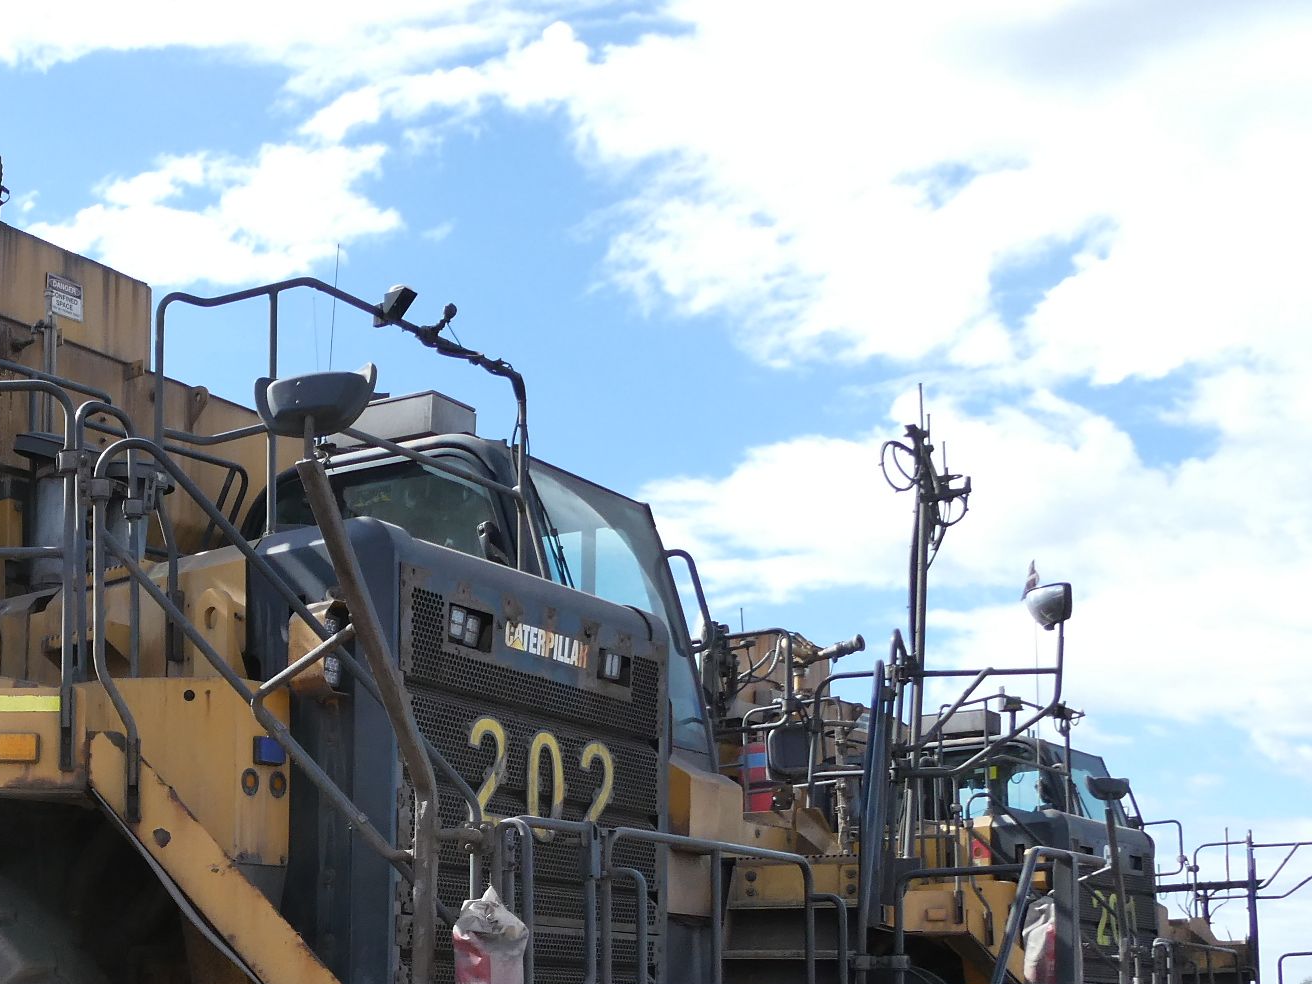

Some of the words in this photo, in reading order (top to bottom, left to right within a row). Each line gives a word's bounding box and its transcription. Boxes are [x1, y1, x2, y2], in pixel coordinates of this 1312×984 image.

[52, 280, 79, 296] DANGER
[55, 299, 73, 311] SPACE
[505, 620, 590, 669] CATERPILLAR
[470, 718, 614, 842] 202
